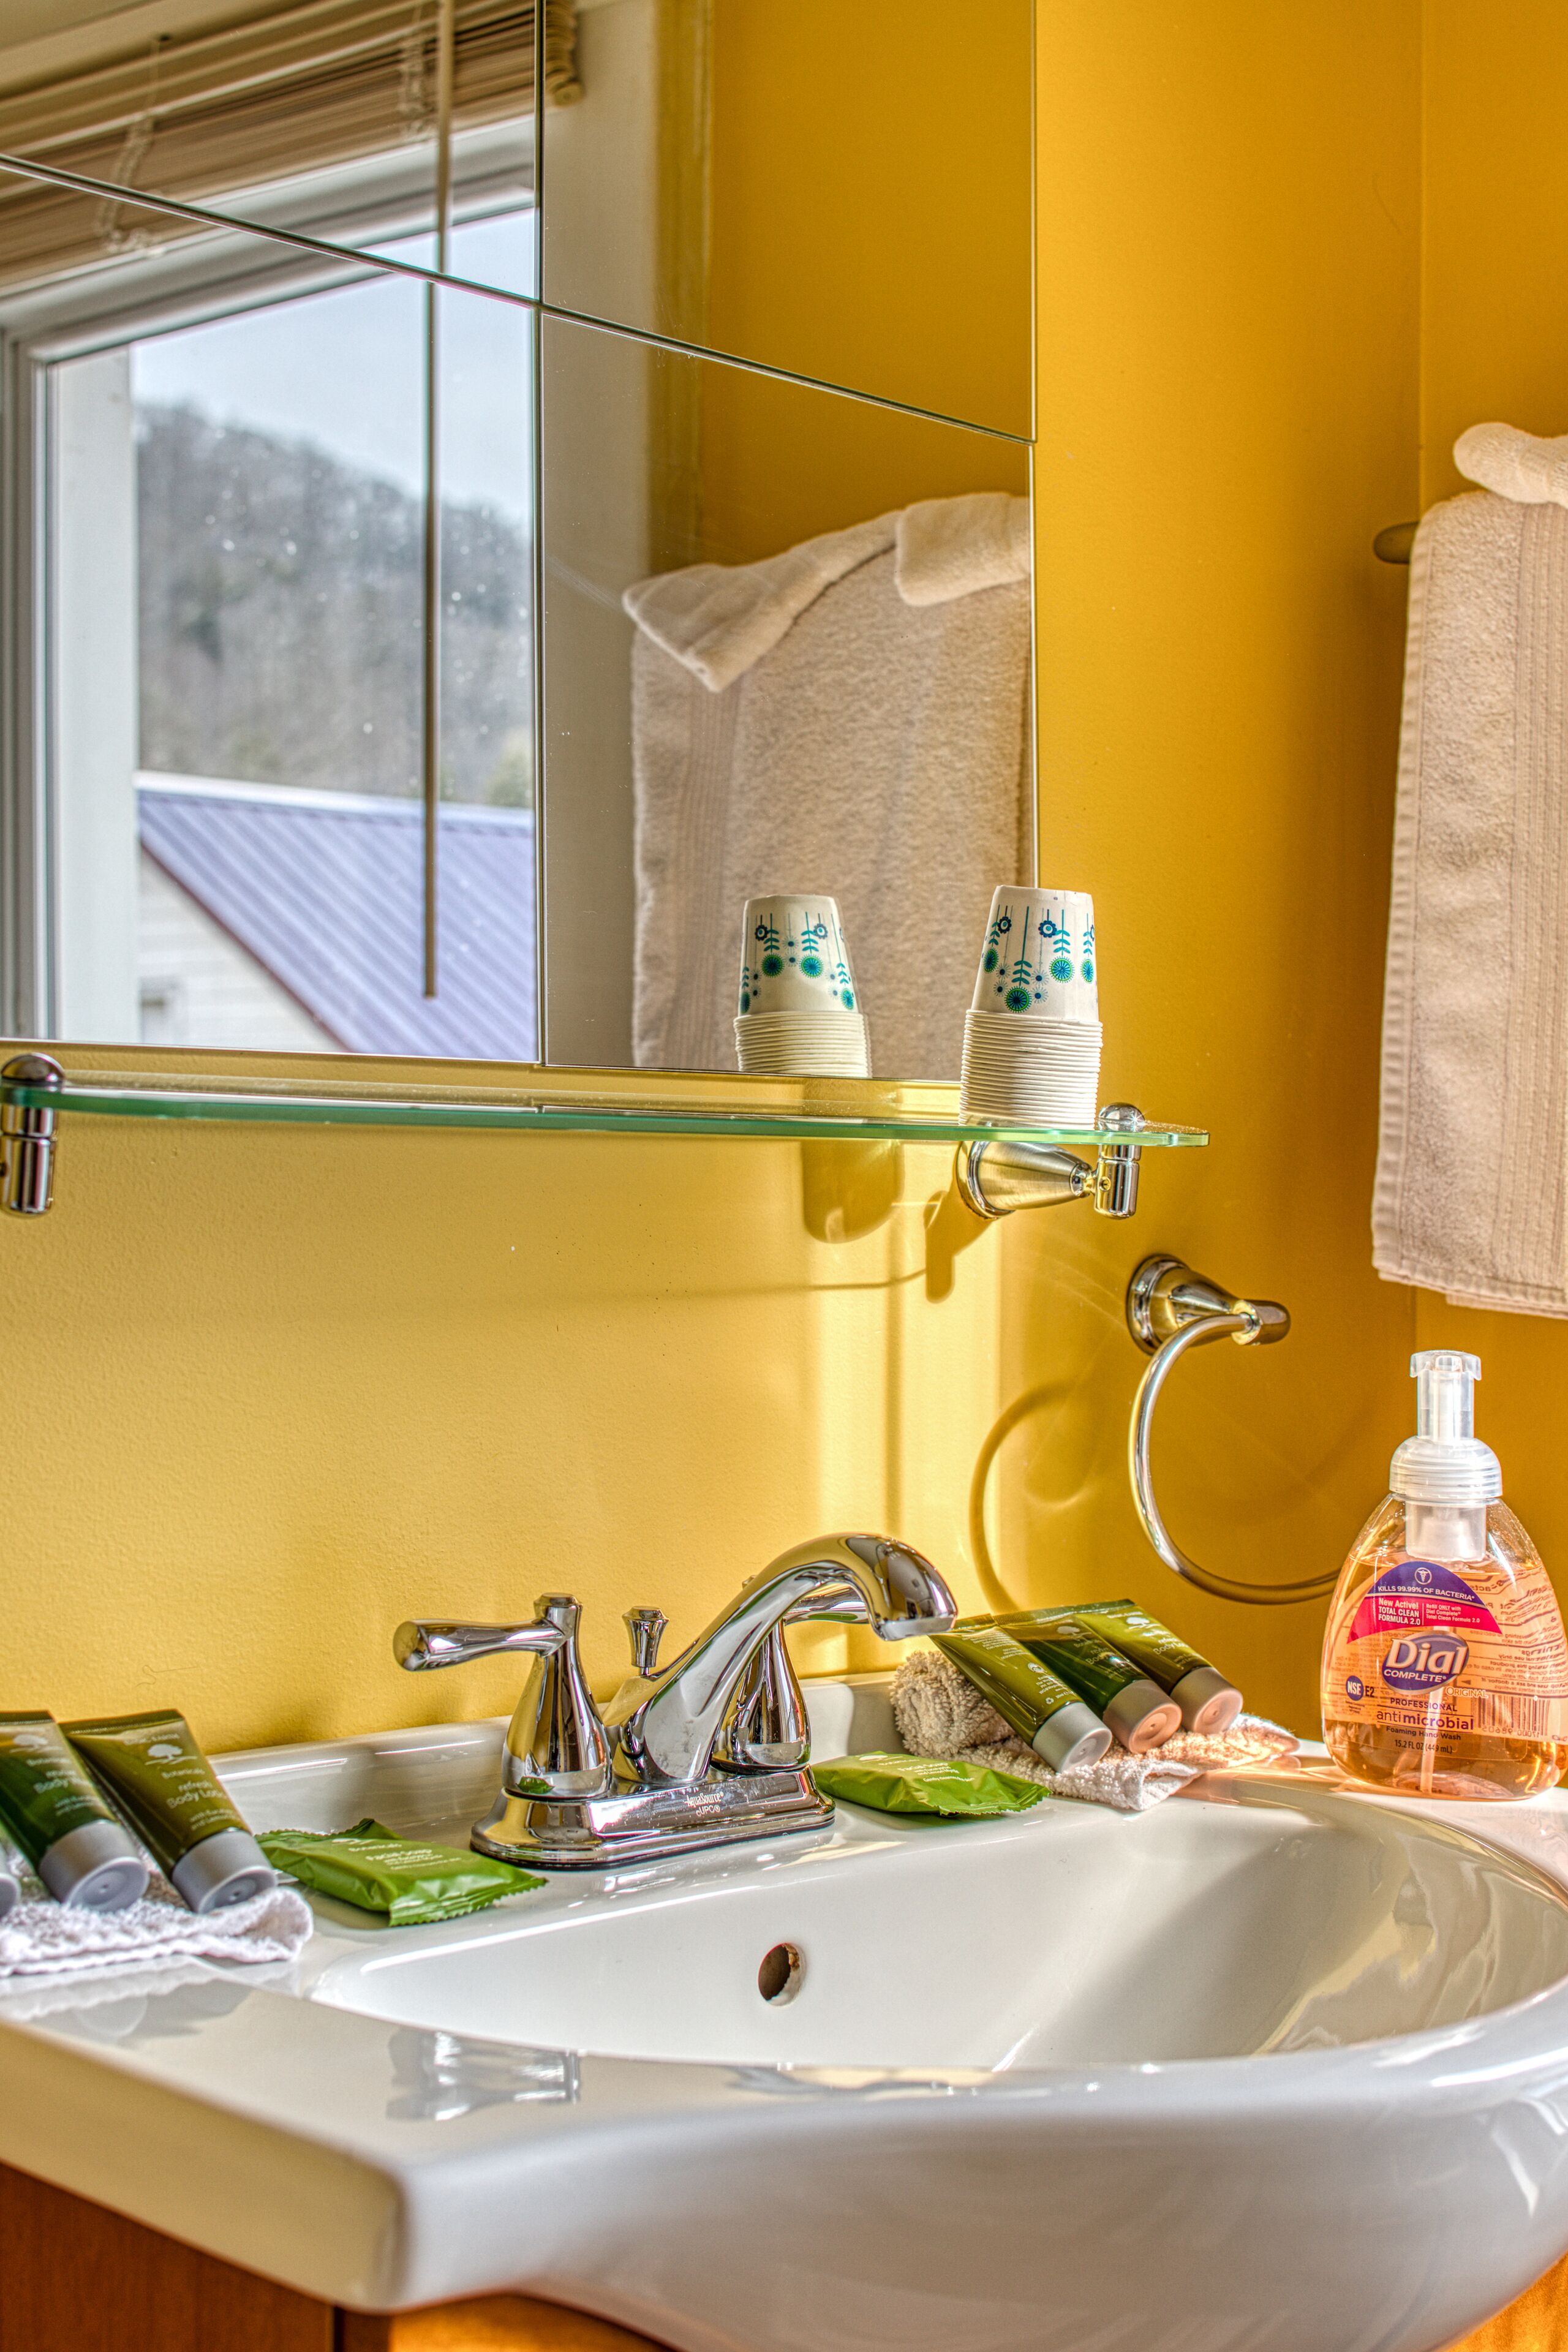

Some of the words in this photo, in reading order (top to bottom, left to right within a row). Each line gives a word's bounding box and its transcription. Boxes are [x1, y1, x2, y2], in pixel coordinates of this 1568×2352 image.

[1378, 1598, 1393, 1607] New
[1395, 1600, 1419, 1610] Active!
[1378, 1607, 1397, 1615] TOTAL
[1398, 1608, 1419, 1618] CLEAN
[1378, 1614, 1409, 1624] FORMULA
[1409, 1617, 1420, 1626] 2.0
[1153, 1643, 1175, 1655] Body
[1385, 1638, 1468, 1675] Dial
[1365, 1685, 1374, 1698] E2
[1390, 1697, 1458, 1712] PROFESSIONAL
[1377, 1710, 1474, 1730] antimicrobial
[1386, 1726, 1417, 1736] Foaming
[1395, 1739, 1407, 1748] 15.2
[1408, 1741, 1415, 1749] FL
[1416, 1742, 1424, 1751] OZ
[1425, 1743, 1439, 1752] (449
[1440, 1746, 1452, 1754] mL)
[166, 1792, 199, 1809] Body
